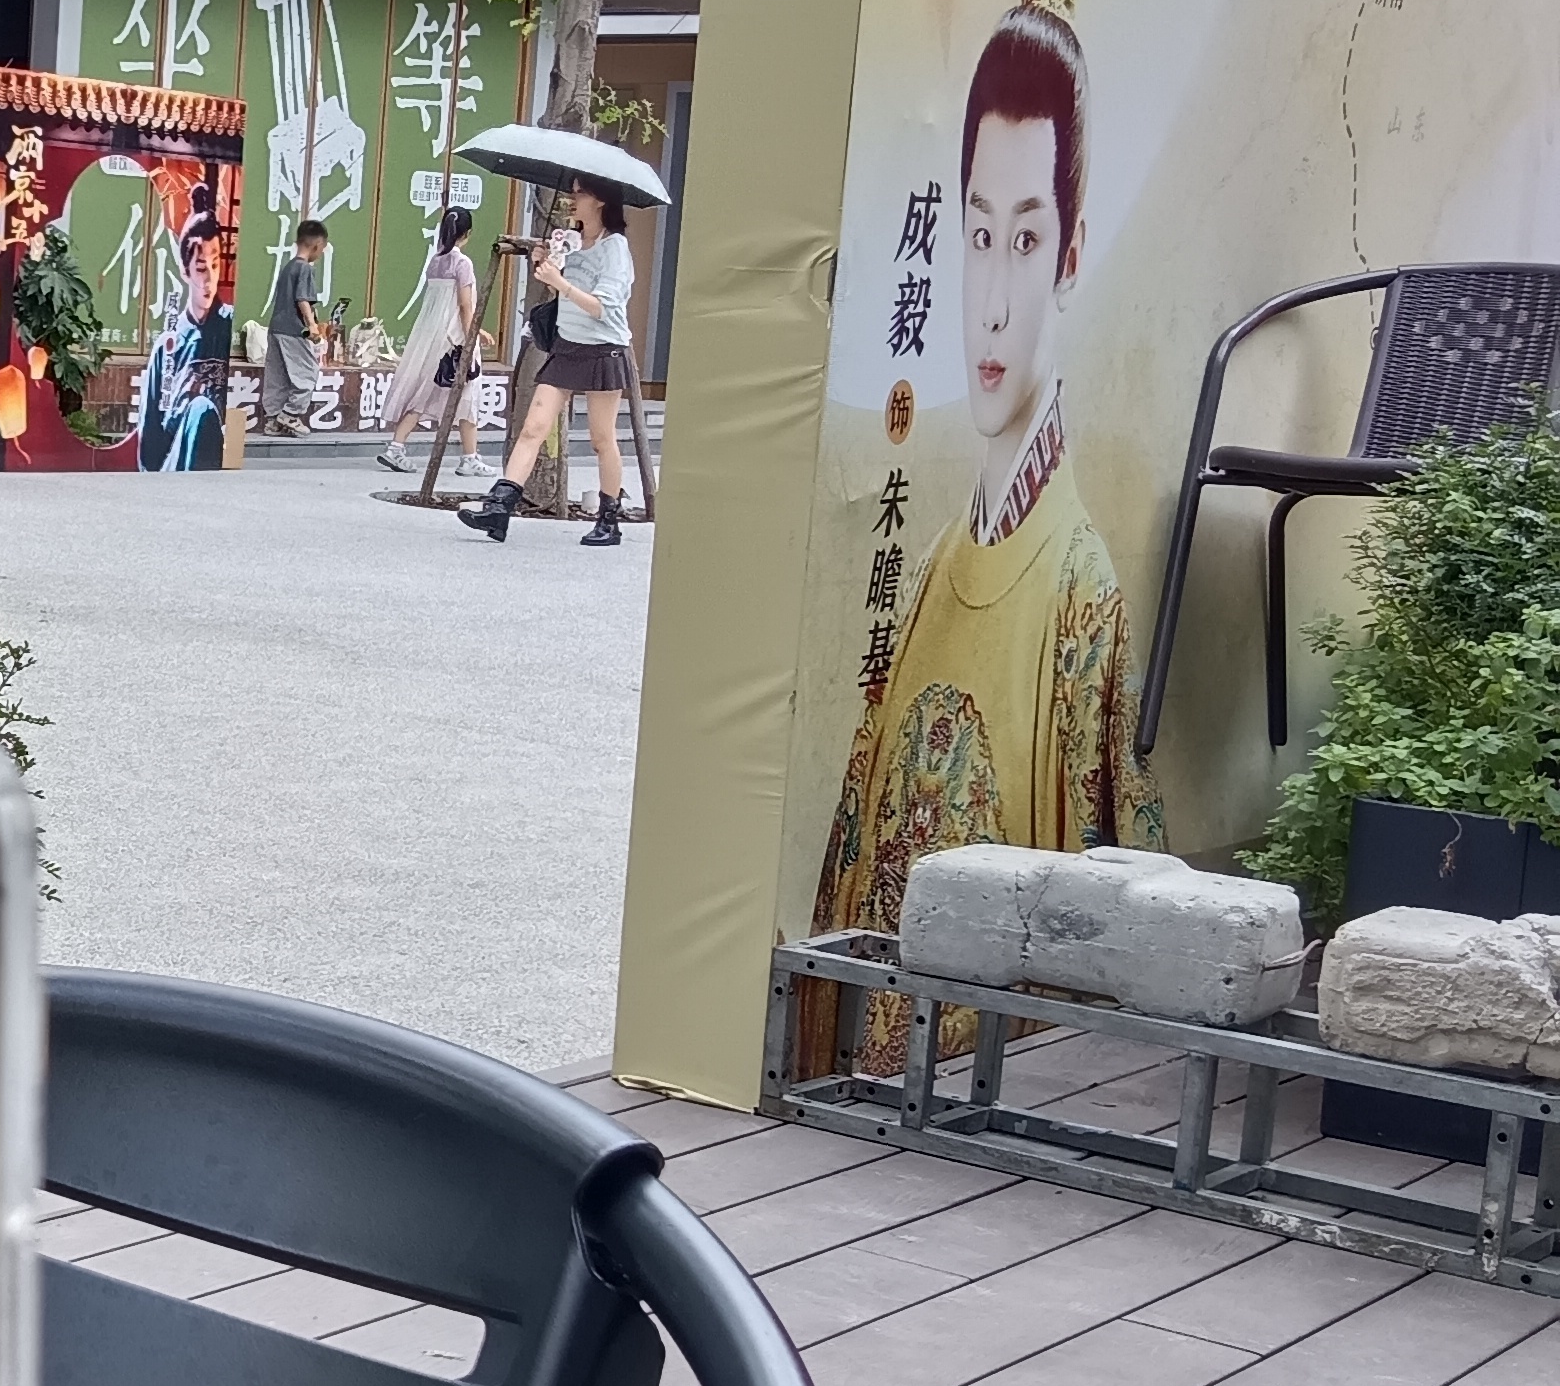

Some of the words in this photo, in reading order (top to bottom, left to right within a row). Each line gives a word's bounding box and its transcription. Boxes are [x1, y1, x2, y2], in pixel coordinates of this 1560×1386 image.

[1386, 106, 1426, 144] 山东
[887, 180, 943, 357] 成毅
[888, 389, 912, 438] 饰
[857, 468, 910, 688] 朱瞻基
